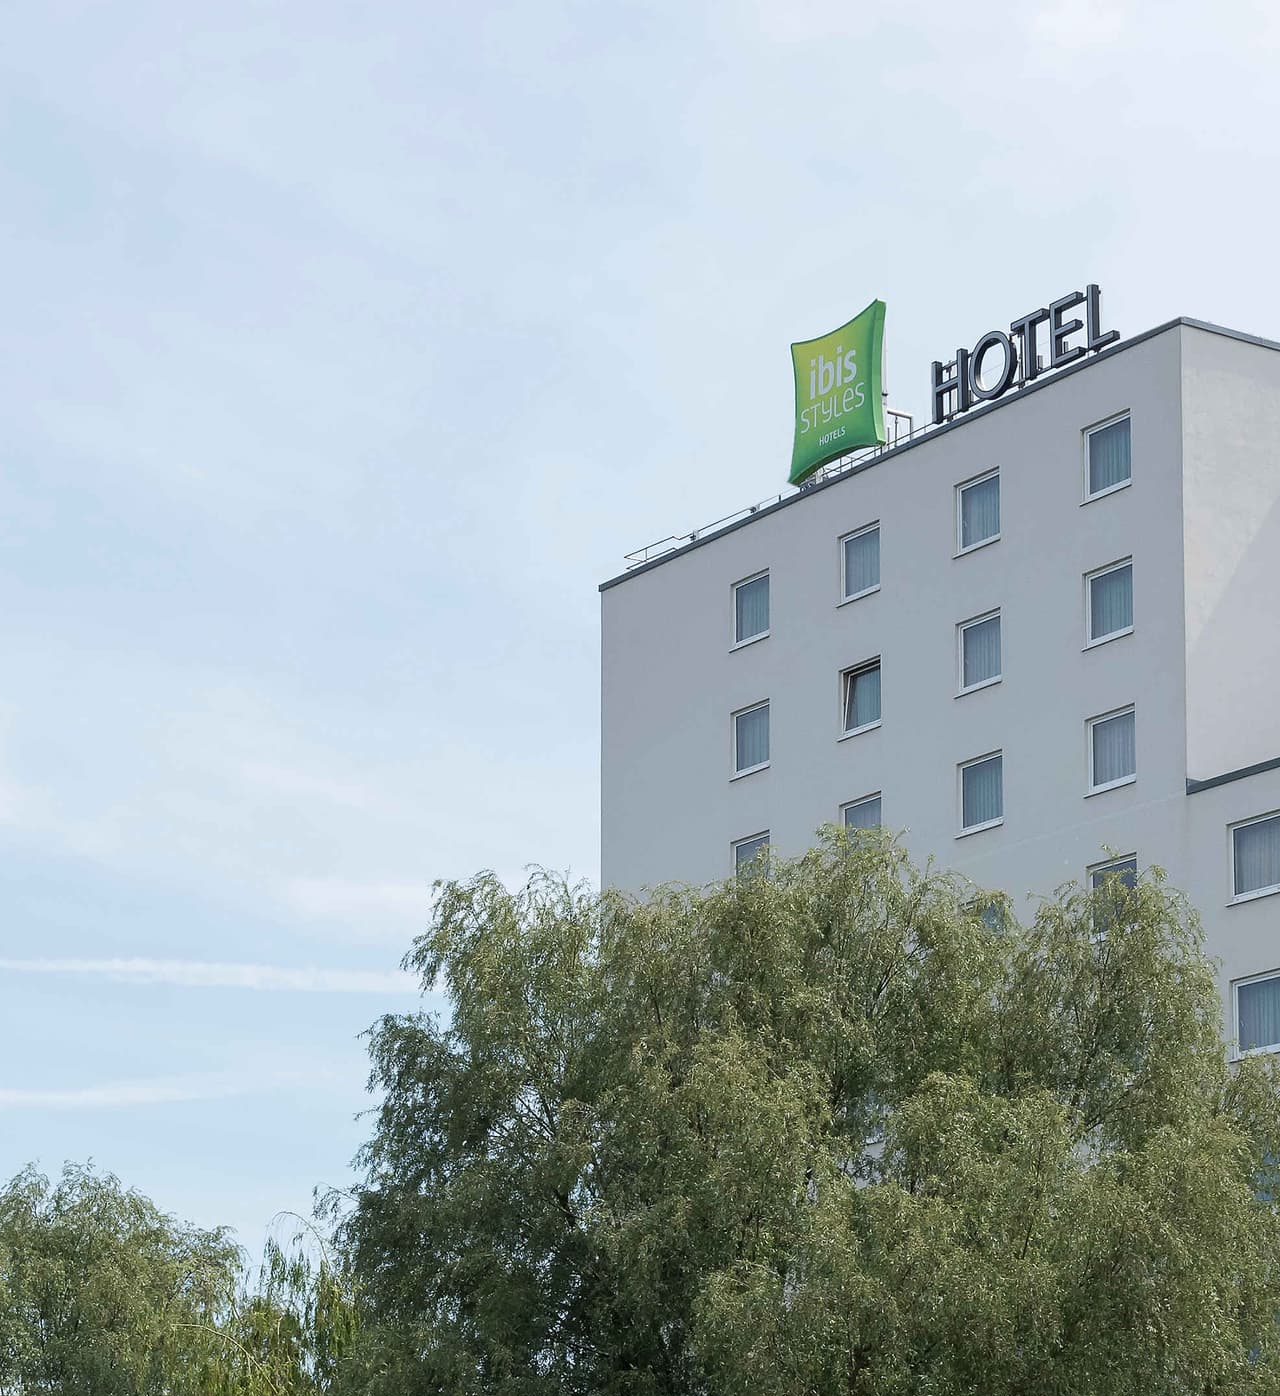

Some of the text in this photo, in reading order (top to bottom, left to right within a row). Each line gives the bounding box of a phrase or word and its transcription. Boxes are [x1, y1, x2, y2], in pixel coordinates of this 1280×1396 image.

[809, 345, 858, 401] ibis
[931, 283, 1120, 424] HOTEL
[818, 425, 847, 446] HOTELS
